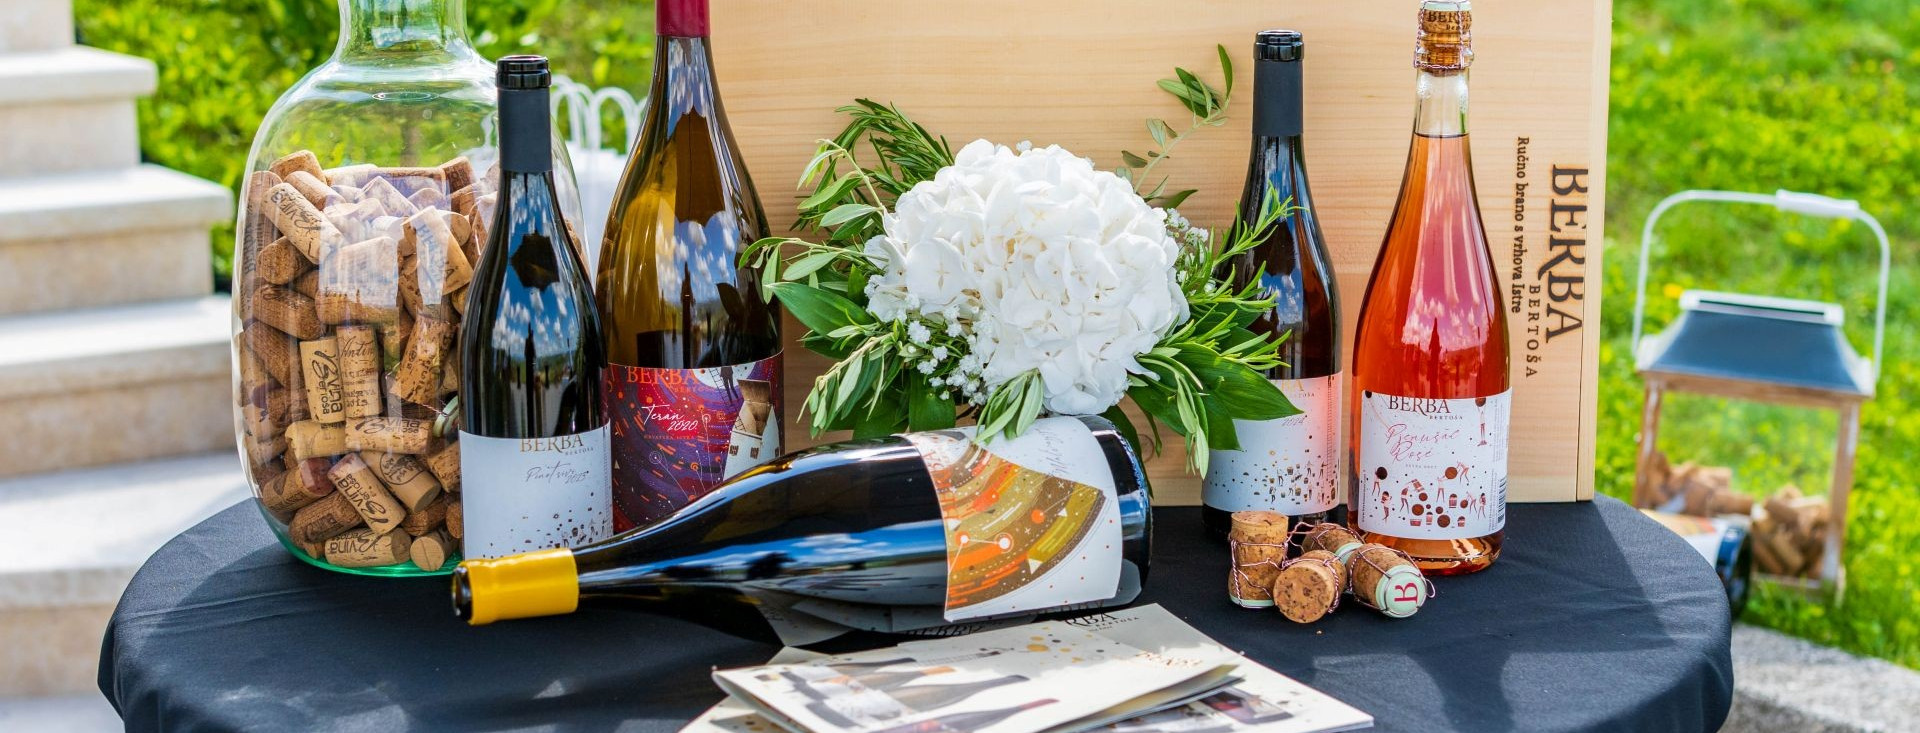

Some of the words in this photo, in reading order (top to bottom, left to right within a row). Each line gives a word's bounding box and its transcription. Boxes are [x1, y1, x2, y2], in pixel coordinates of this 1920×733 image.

[1516, 136, 1530, 179] Ručno
[1514, 182, 1530, 223] brano
[1511, 235, 1528, 280] vrhova
[1537, 164, 1589, 344] BERBA
[1510, 280, 1526, 314] Istre
[1525, 284, 1542, 378] BERTOŠA
[626, 366, 701, 389] BERBA
[641, 403, 685, 426] Teran
[1387, 395, 1452, 417] BERBA
[520, 433, 584, 454] BERBA
[1393, 581, 1420, 604] B
